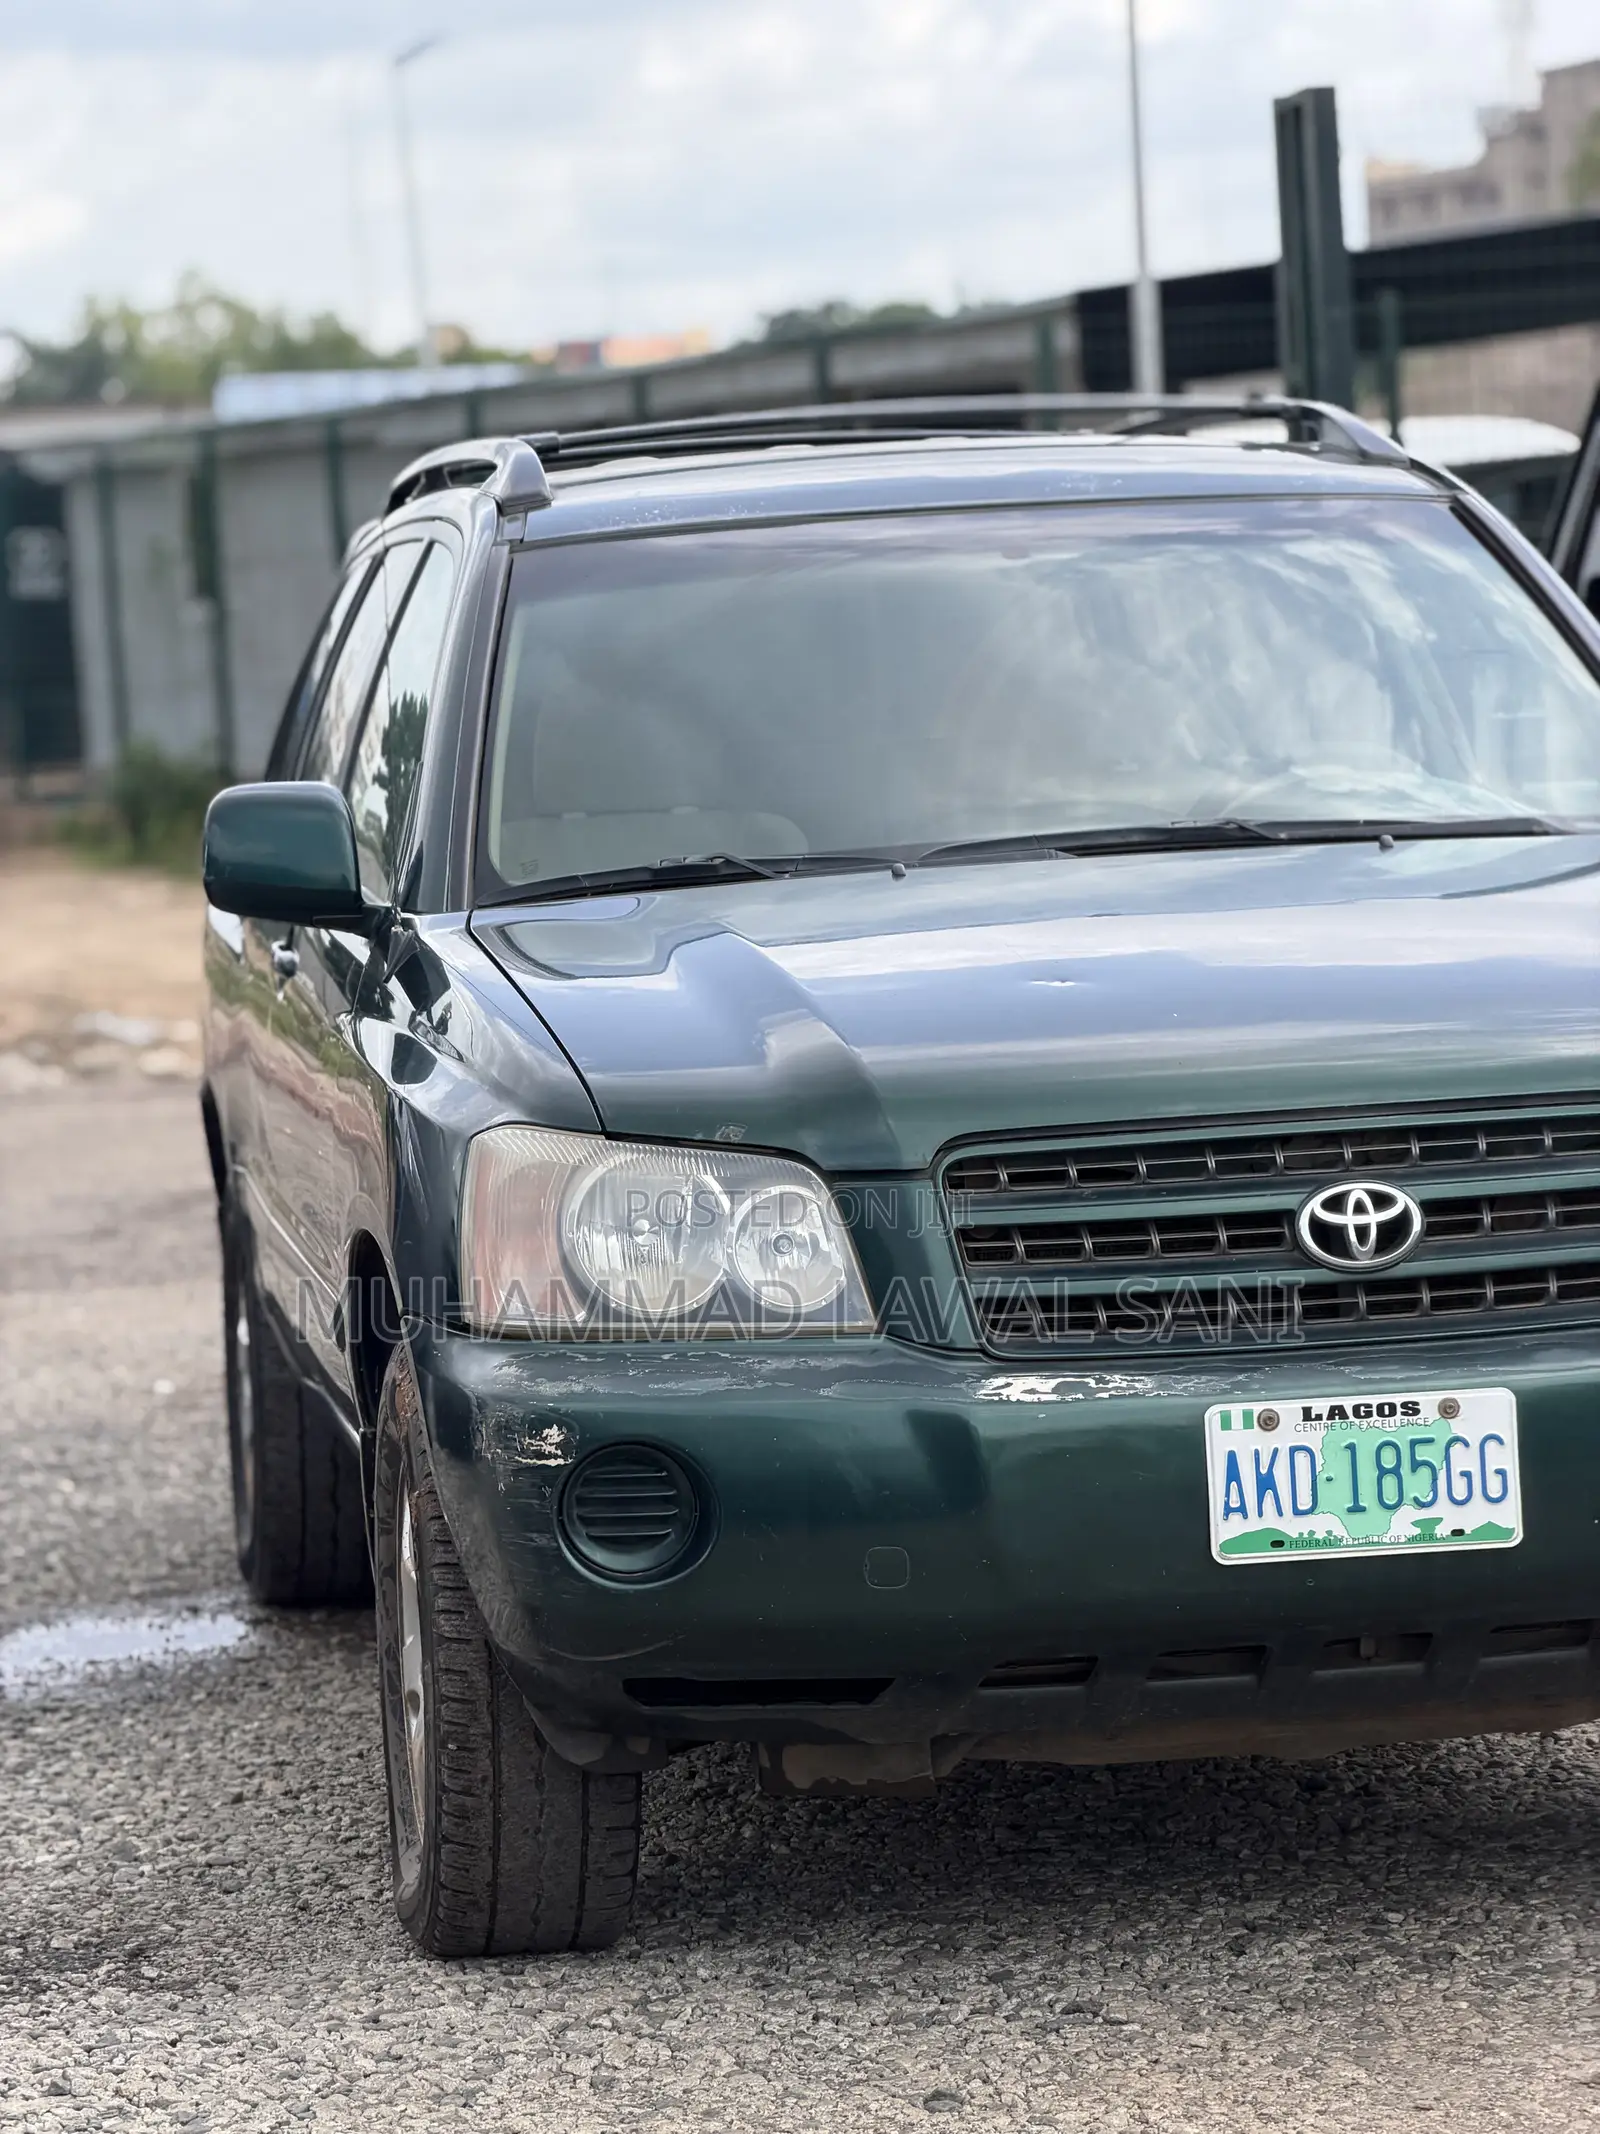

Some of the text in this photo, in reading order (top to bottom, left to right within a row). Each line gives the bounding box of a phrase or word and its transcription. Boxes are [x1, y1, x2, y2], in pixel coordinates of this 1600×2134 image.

[1301, 1400, 1421, 1422] LAGOS
[1294, 1417, 1430, 1433] CENTRE OF EXCELLENCE
[1289, 1532, 1446, 1549] FEDERAL REPUBLIC OF NIGERIA
